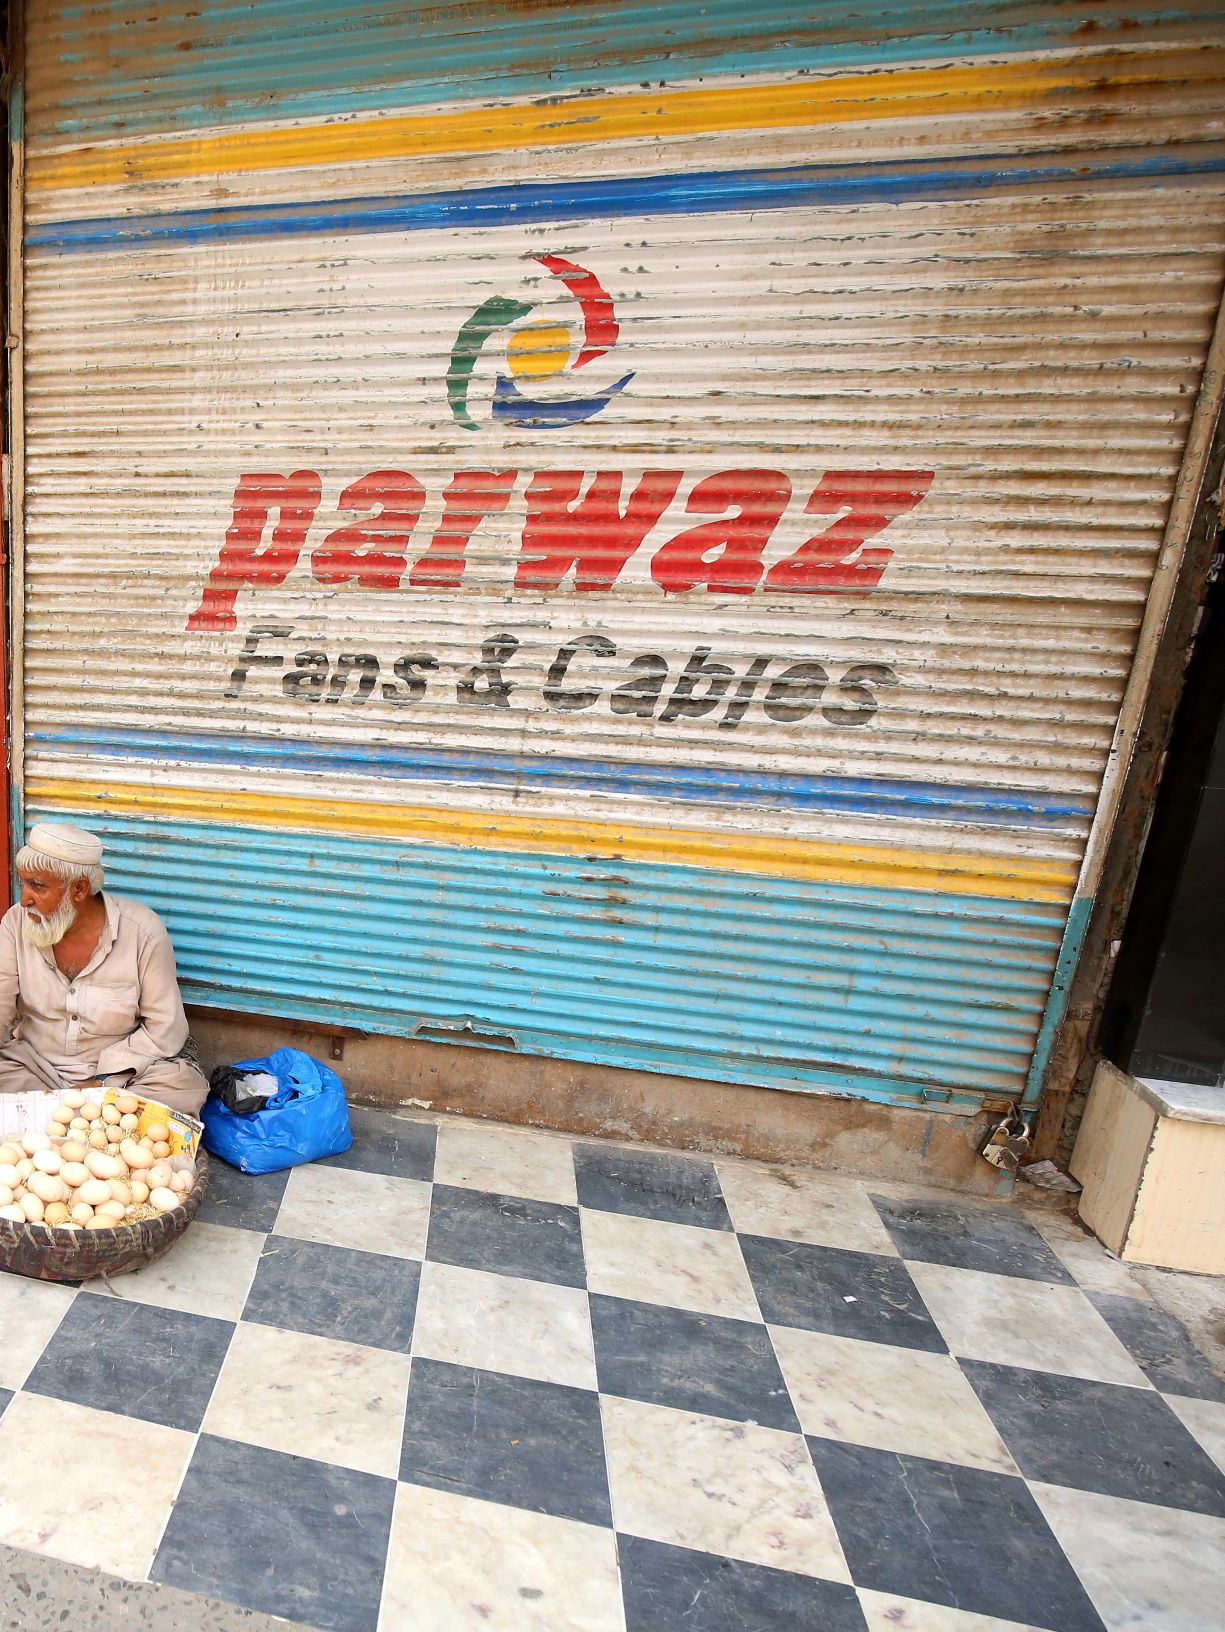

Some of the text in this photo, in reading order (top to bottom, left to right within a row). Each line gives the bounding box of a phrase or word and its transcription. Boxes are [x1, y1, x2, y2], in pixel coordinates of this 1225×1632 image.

[185, 469, 936, 632] parwaz
[223, 624, 900, 729] Fans & Cables
